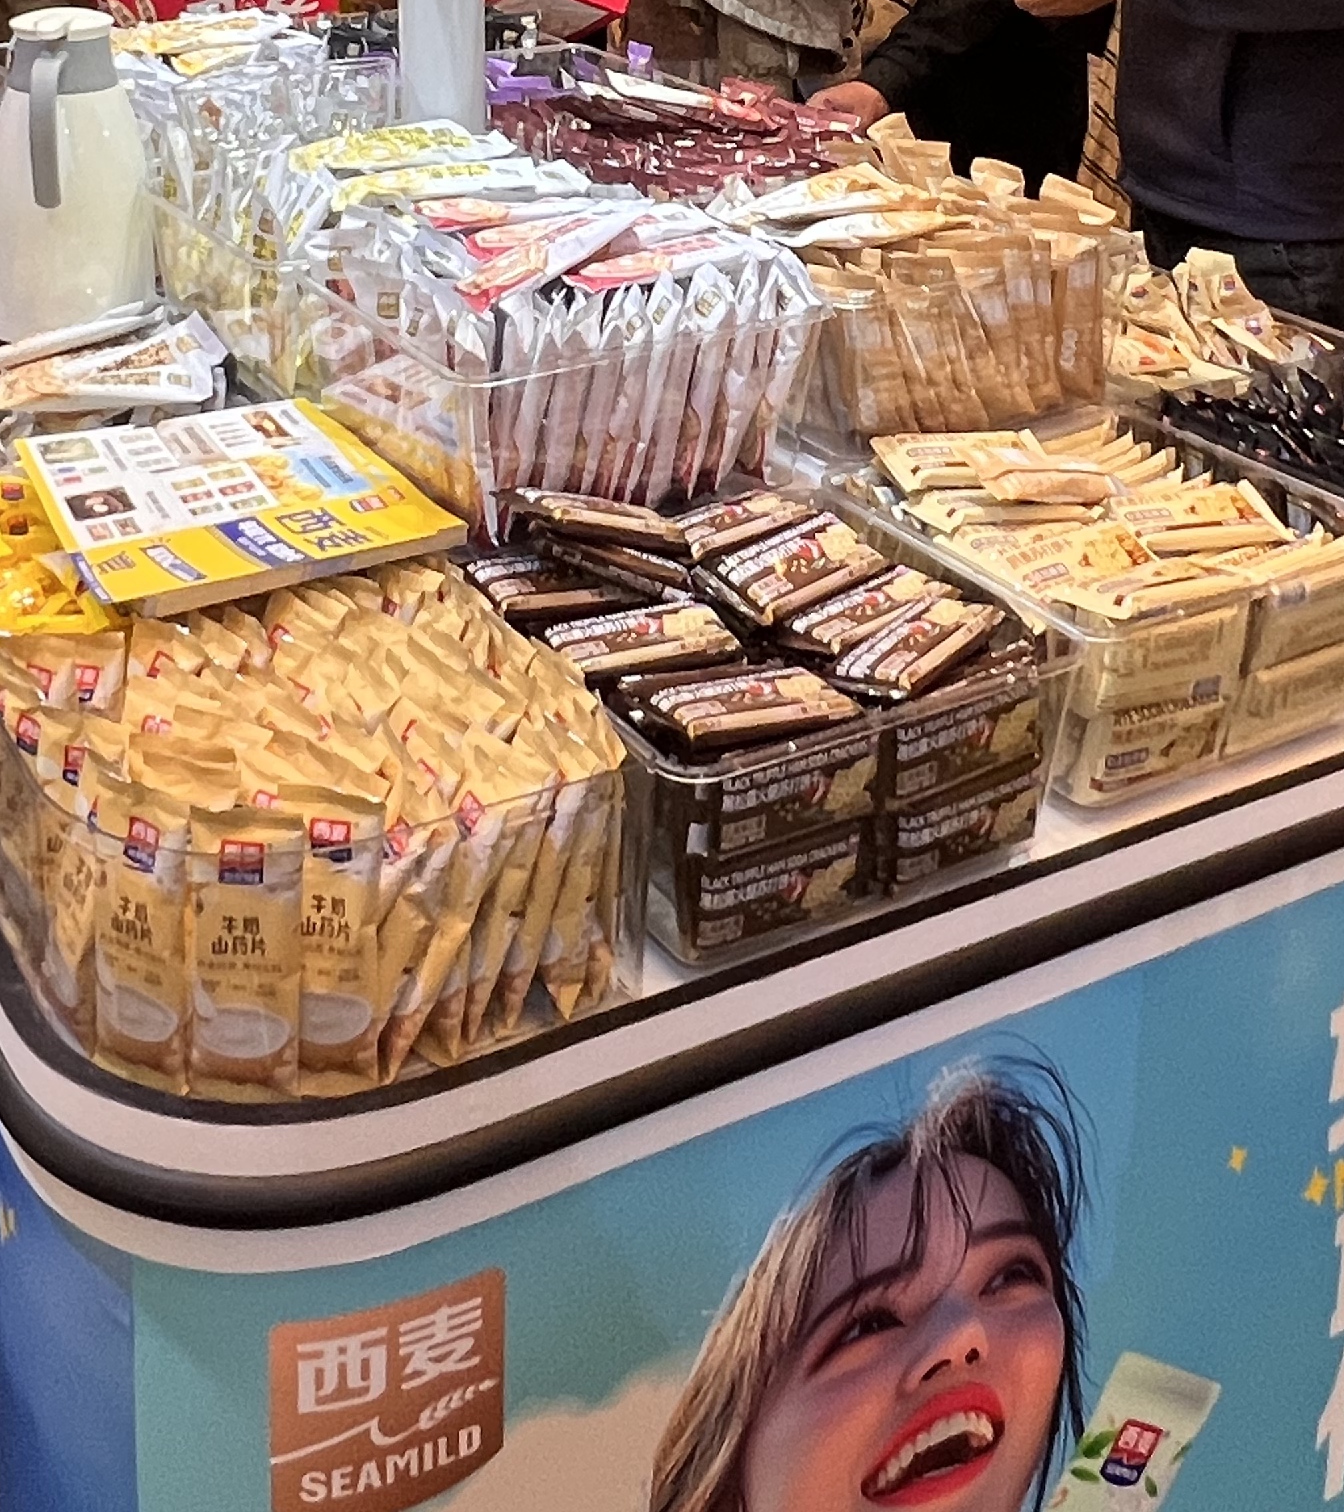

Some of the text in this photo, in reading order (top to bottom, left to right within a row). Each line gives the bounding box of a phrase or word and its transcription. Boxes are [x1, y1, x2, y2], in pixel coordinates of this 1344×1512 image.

[211, 935, 268, 957] 山药片
[296, 1295, 483, 1416] 西麦
[299, 1423, 483, 1505] SEAMILD
